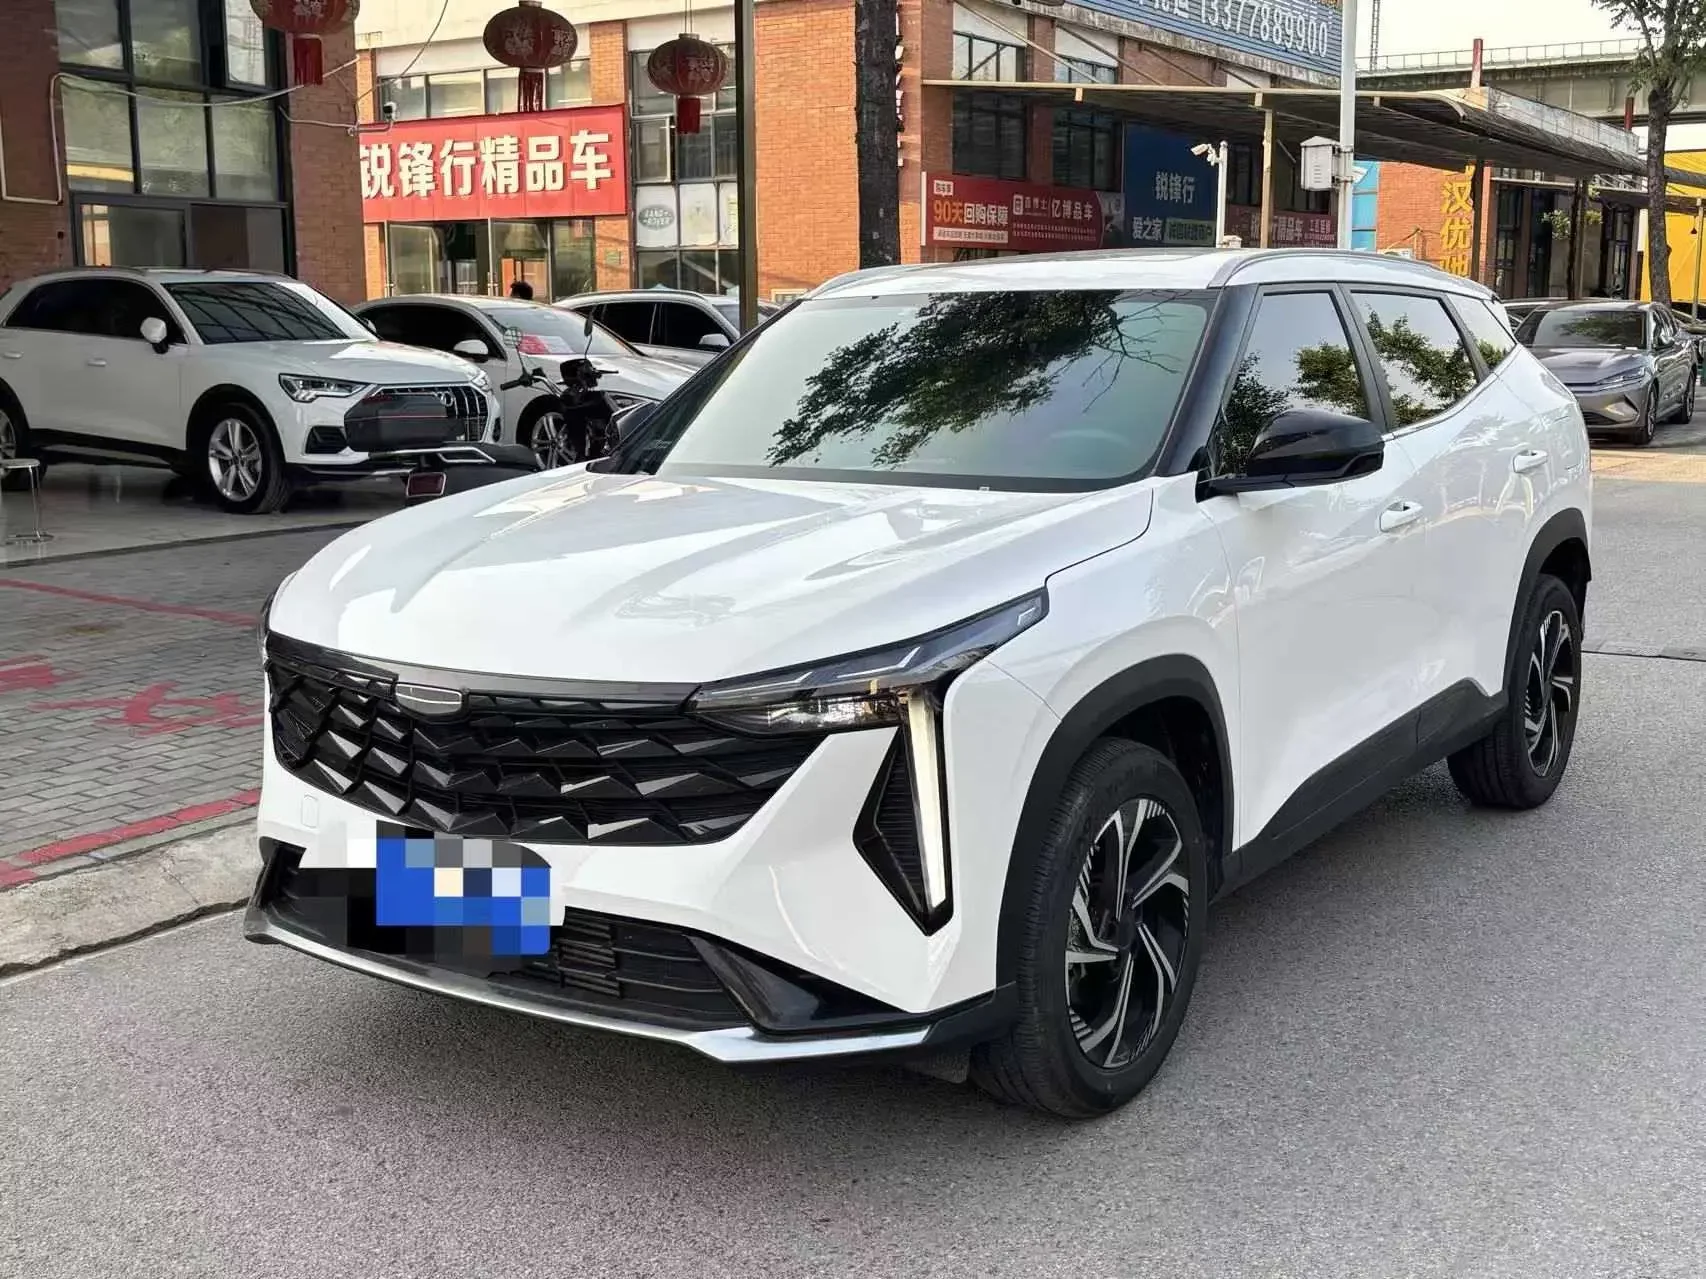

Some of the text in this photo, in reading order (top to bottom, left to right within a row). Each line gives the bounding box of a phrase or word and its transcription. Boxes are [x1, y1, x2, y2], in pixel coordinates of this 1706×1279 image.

[1201, 0, 1328, 58] 13377889900
[360, 130, 613, 199] 锐锋行精品车
[1155, 171, 1195, 204] 锐锋行
[933, 200, 1009, 227] 90天回购保障
